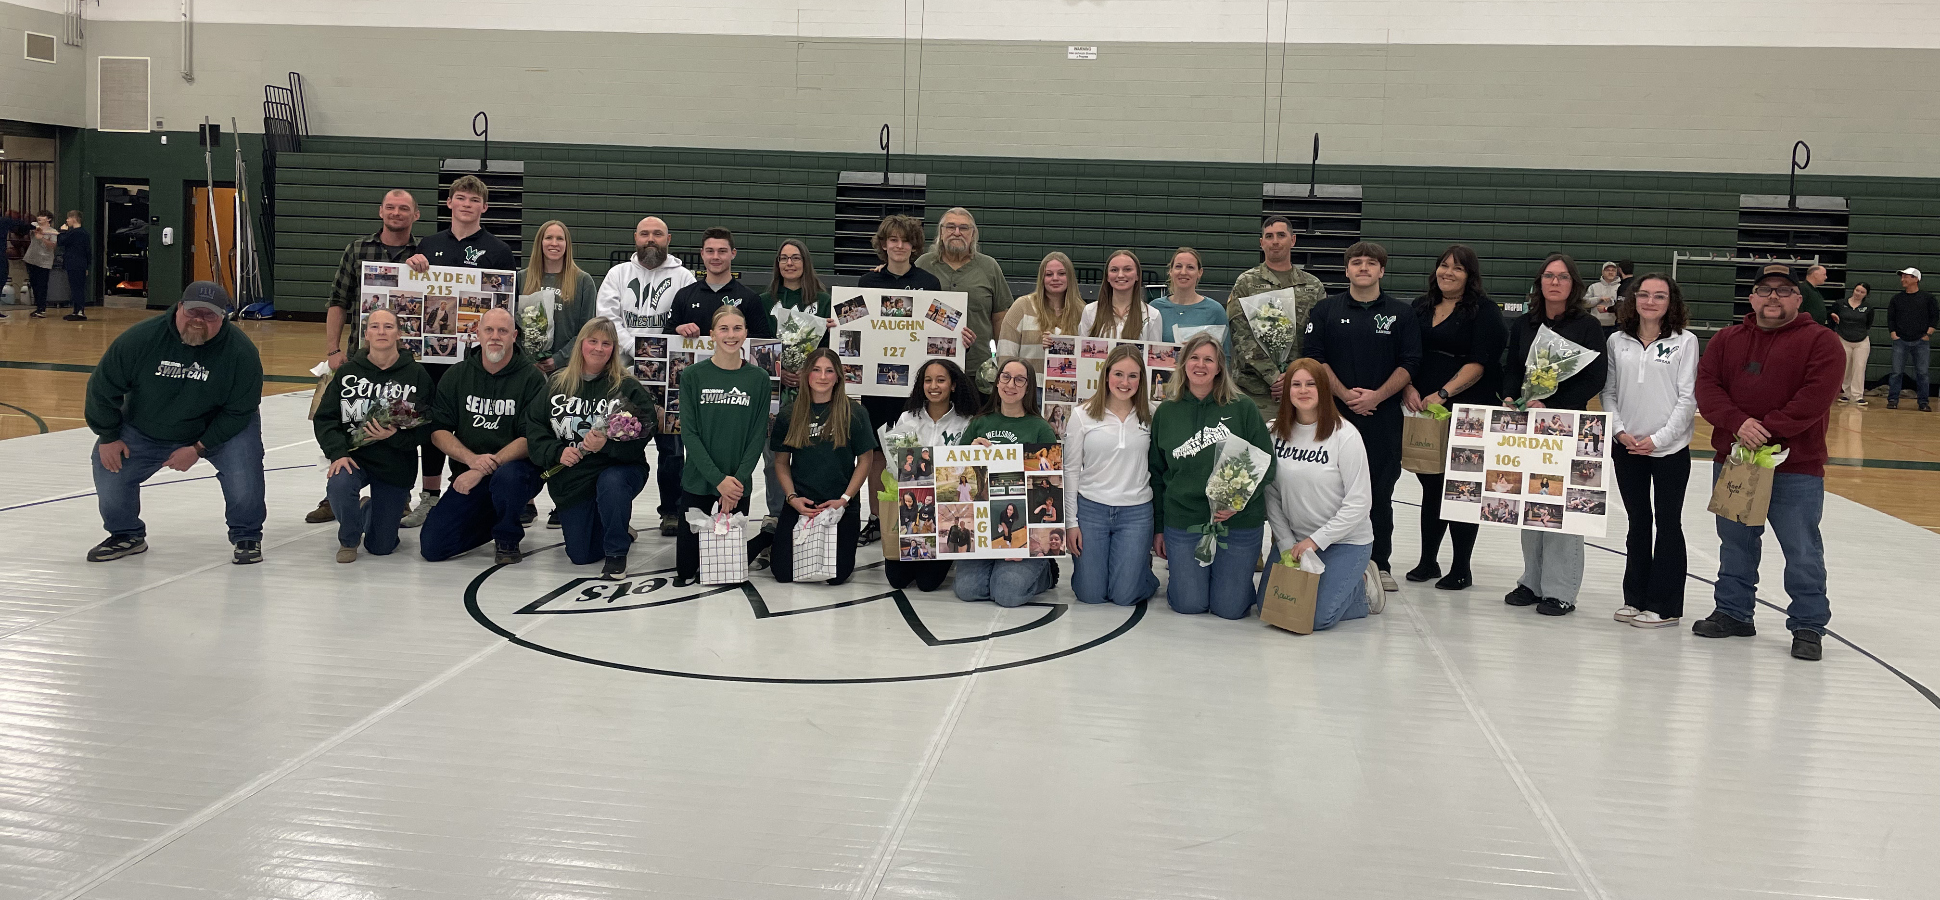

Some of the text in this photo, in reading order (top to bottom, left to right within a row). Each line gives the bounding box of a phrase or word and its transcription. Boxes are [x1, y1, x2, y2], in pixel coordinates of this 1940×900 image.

[409, 269, 476, 285] HAYDEN
[427, 285, 452, 296] 215
[624, 311, 668, 328] WRESTLIN
[870, 320, 925, 331] VAUGHN
[682, 338, 715, 351] MAS
[909, 331, 920, 342] S.
[883, 346, 907, 357] 127
[341, 374, 417, 401] Senior
[465, 394, 516, 416] SENIOR
[550, 393, 621, 417] Senior
[472, 414, 502, 430] Dad
[1274, 437, 1329, 465] Hornets
[1497, 435, 1563, 451] JORDAN
[946, 448, 1017, 462] ANIYAH
[1495, 452, 1558, 468] 106 R.
